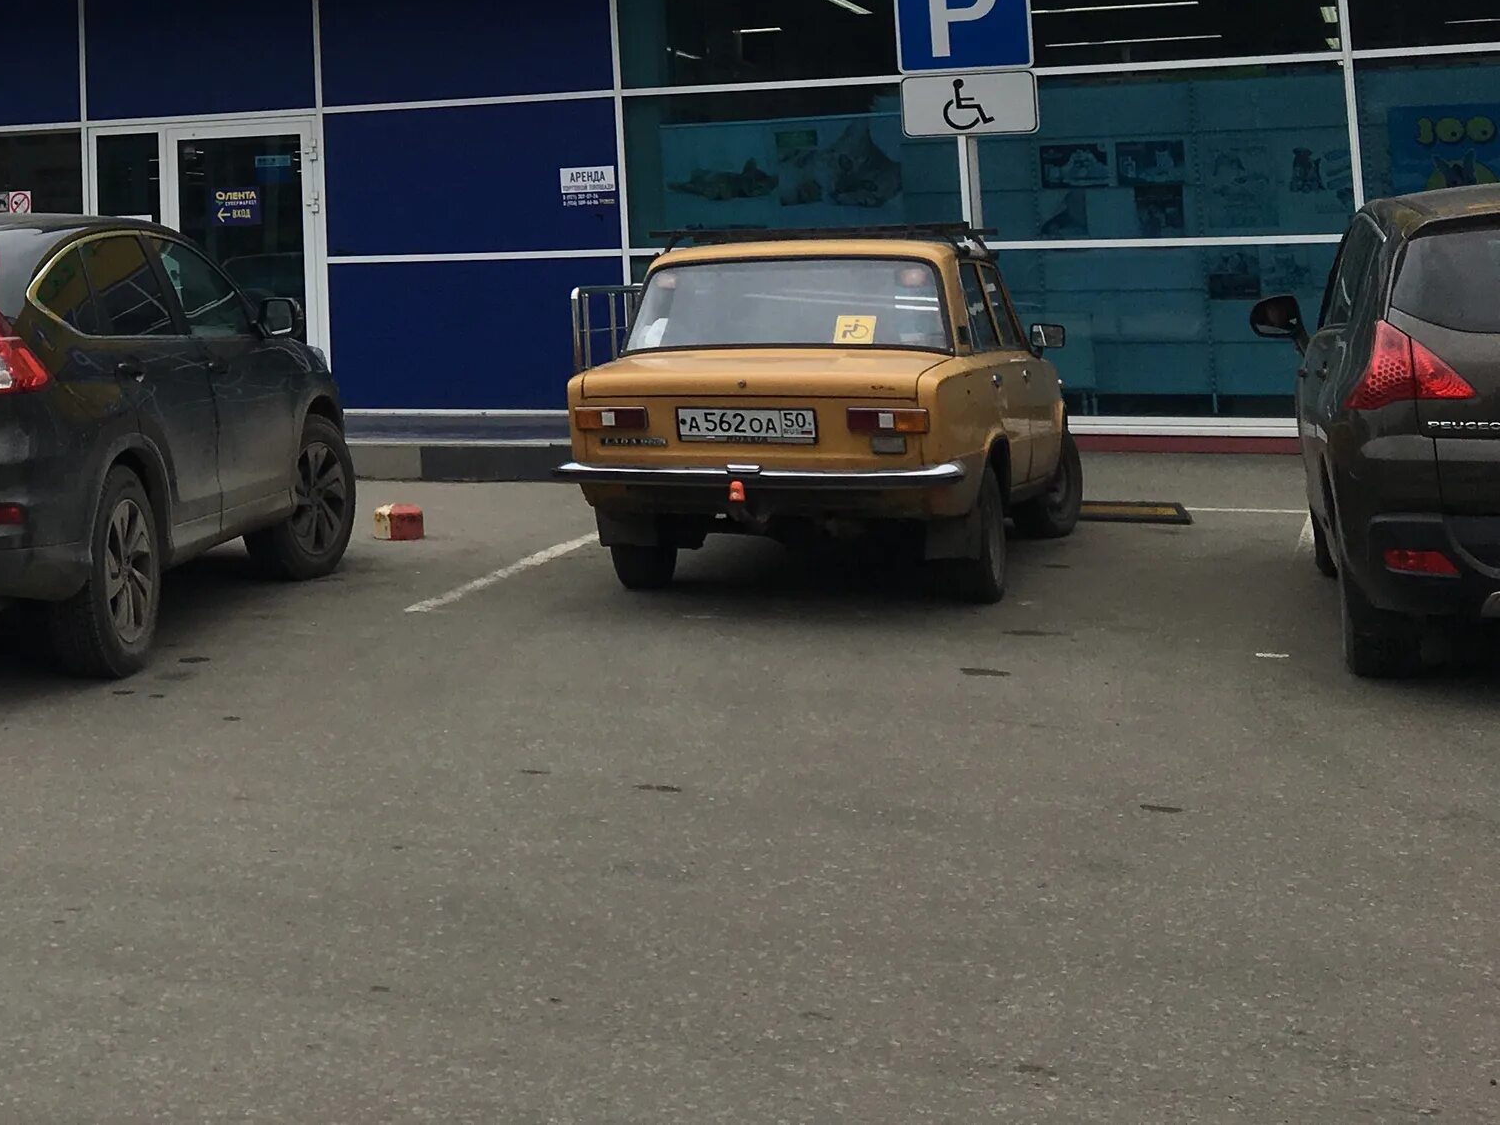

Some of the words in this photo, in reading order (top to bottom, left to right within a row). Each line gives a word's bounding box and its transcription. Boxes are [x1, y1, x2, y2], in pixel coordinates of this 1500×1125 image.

[570, 170, 606, 183] АРЕНДА
[225, 190, 257, 200] ЛЕНТА
[232, 208, 251, 219] ВХОД
[688, 412, 778, 434] А562ОА
[783, 412, 806, 428] 50
